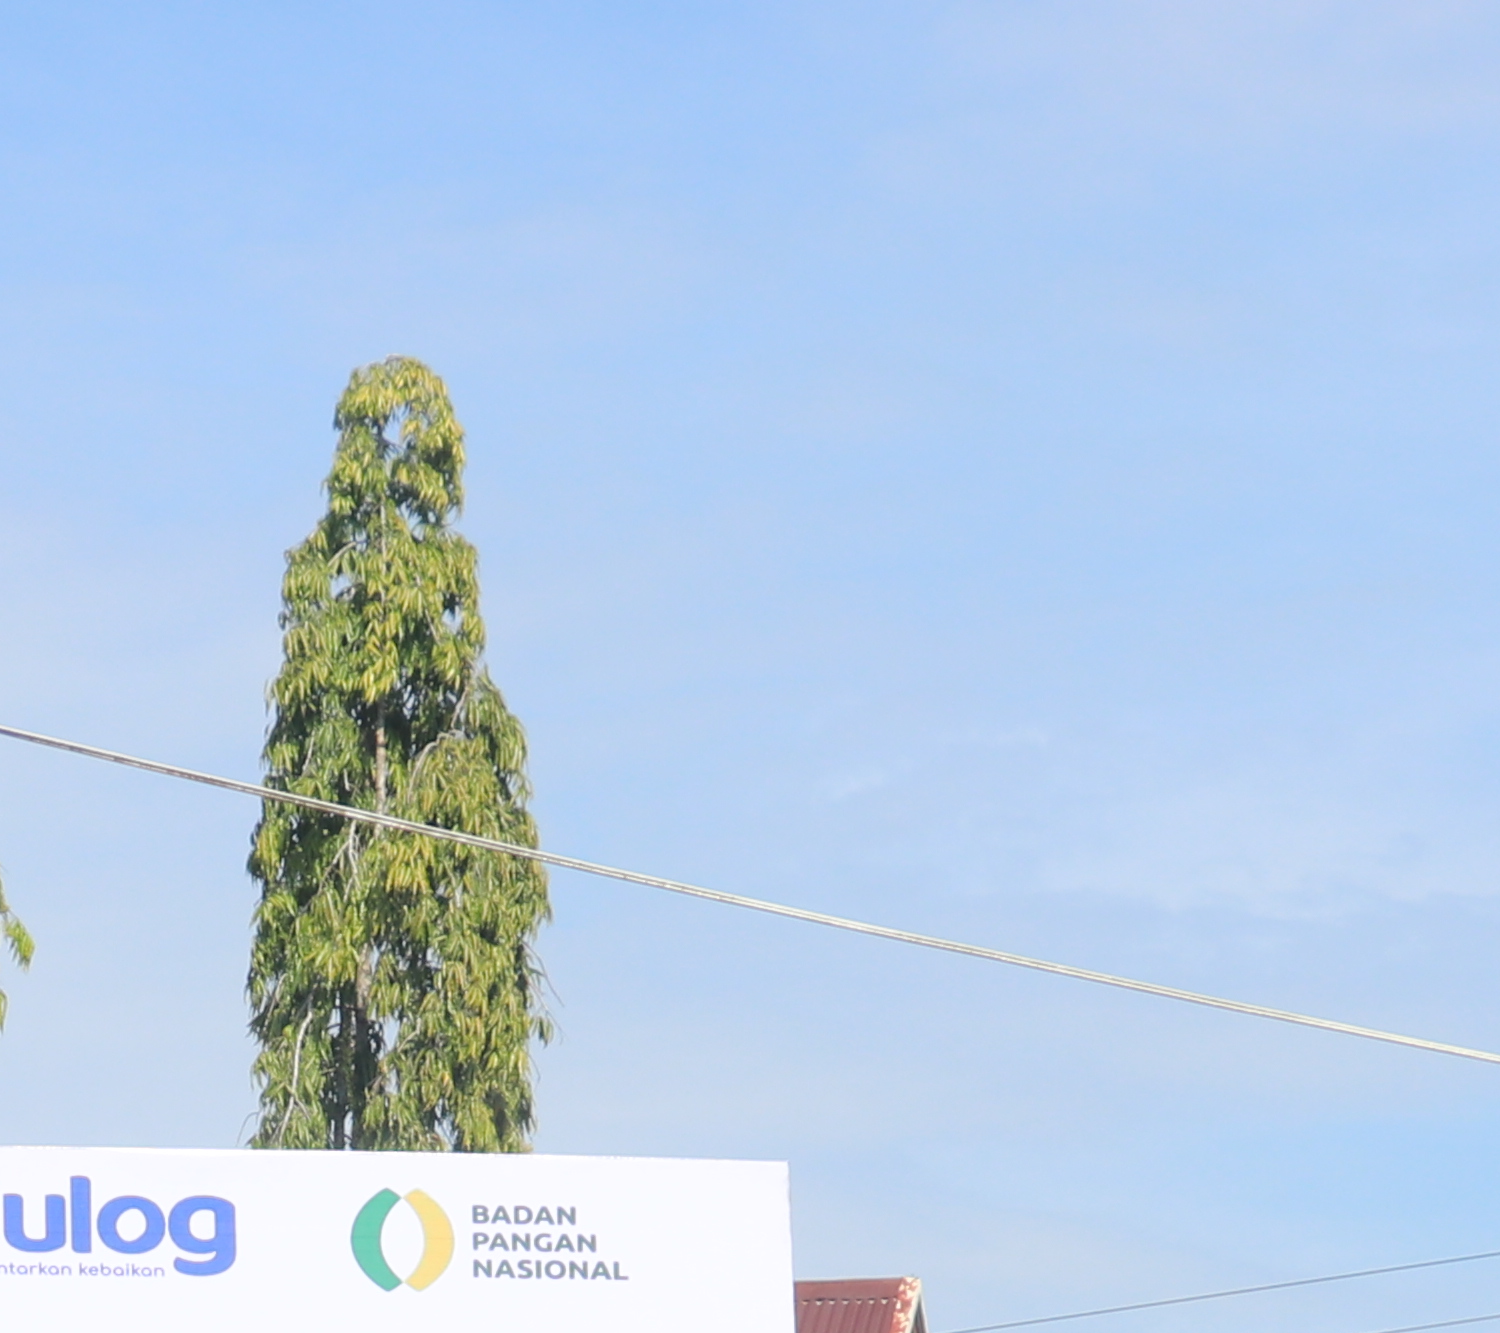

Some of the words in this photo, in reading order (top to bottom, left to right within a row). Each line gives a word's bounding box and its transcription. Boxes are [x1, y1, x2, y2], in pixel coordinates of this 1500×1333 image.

[471, 1204, 577, 1226] BADAN
[472, 1232, 597, 1253] PANGAN
[78, 1263, 166, 1278] kebaikan
[472, 1259, 629, 1281] NASIONAL
